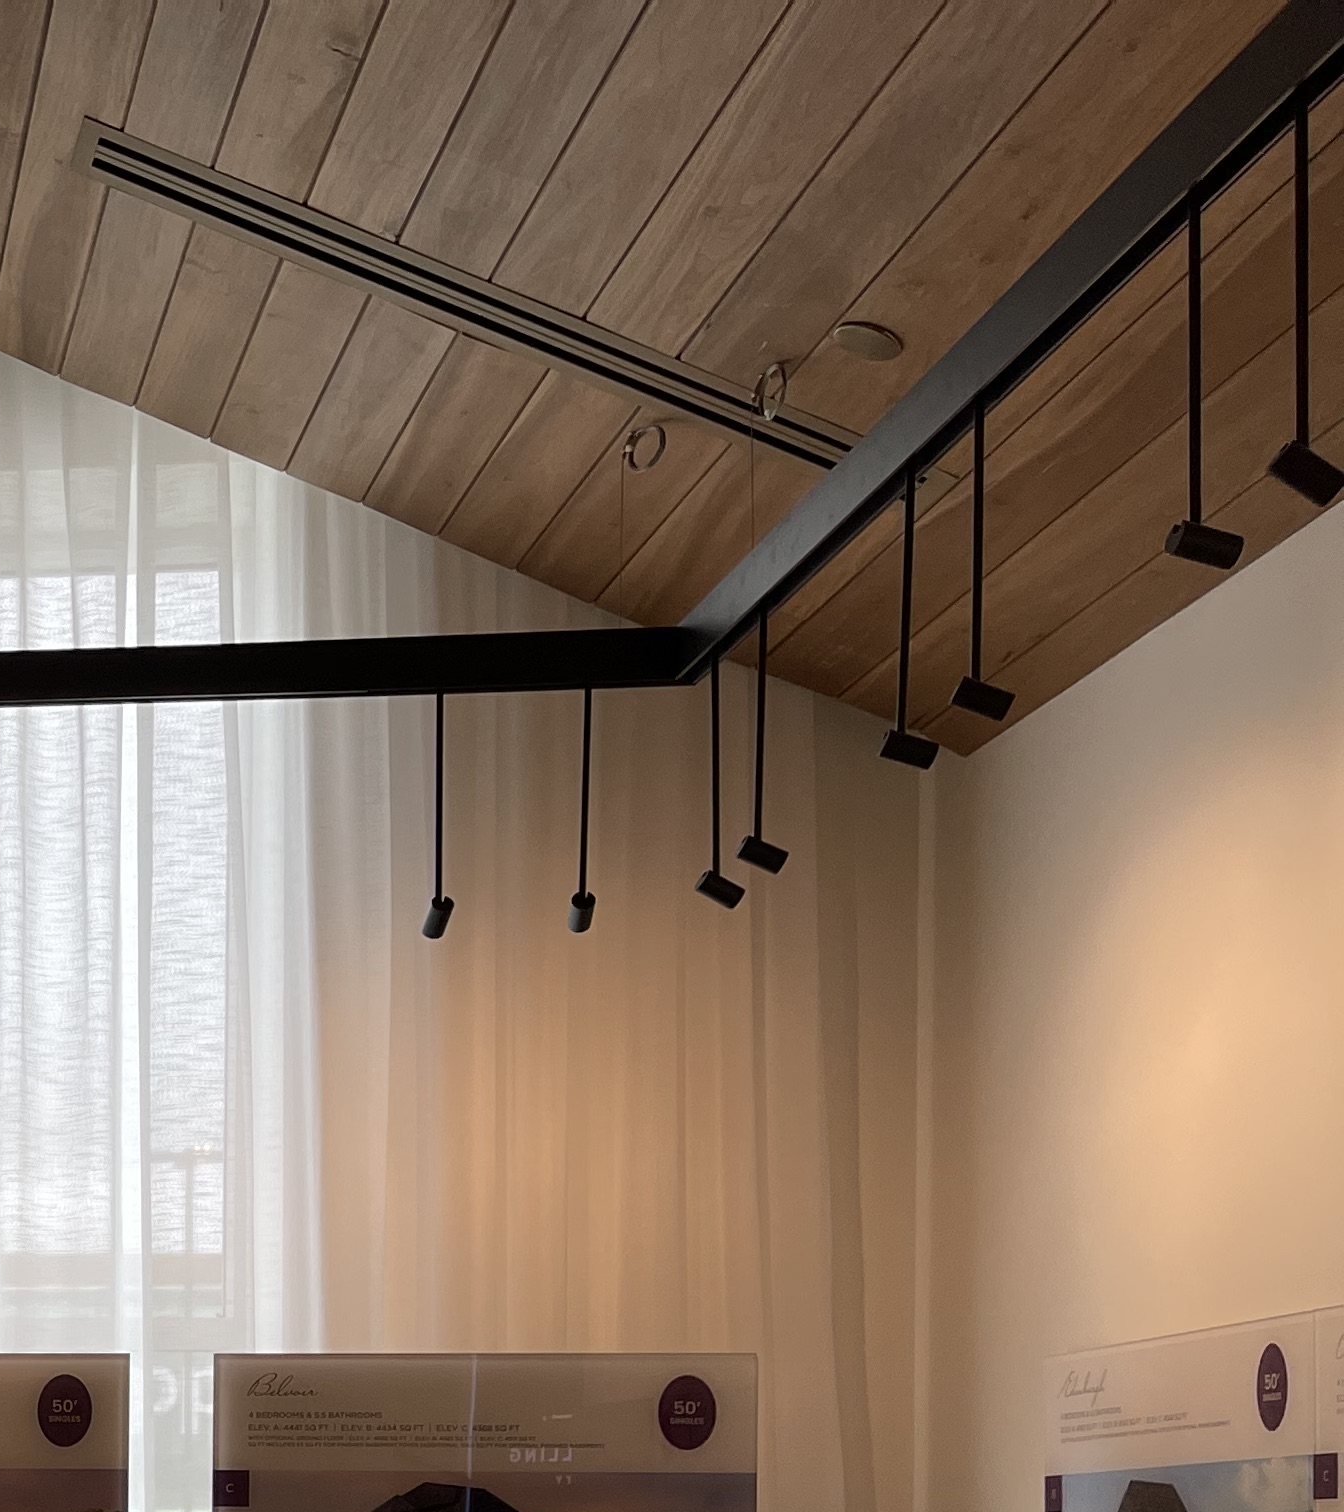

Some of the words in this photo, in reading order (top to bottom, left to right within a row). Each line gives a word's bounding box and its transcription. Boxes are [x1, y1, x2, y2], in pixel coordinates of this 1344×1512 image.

[48, 1415, 81, 1423] SINGLES
[256, 1411, 305, 1419] BEDROOMS
[328, 1411, 382, 1419] BATHROOMS
